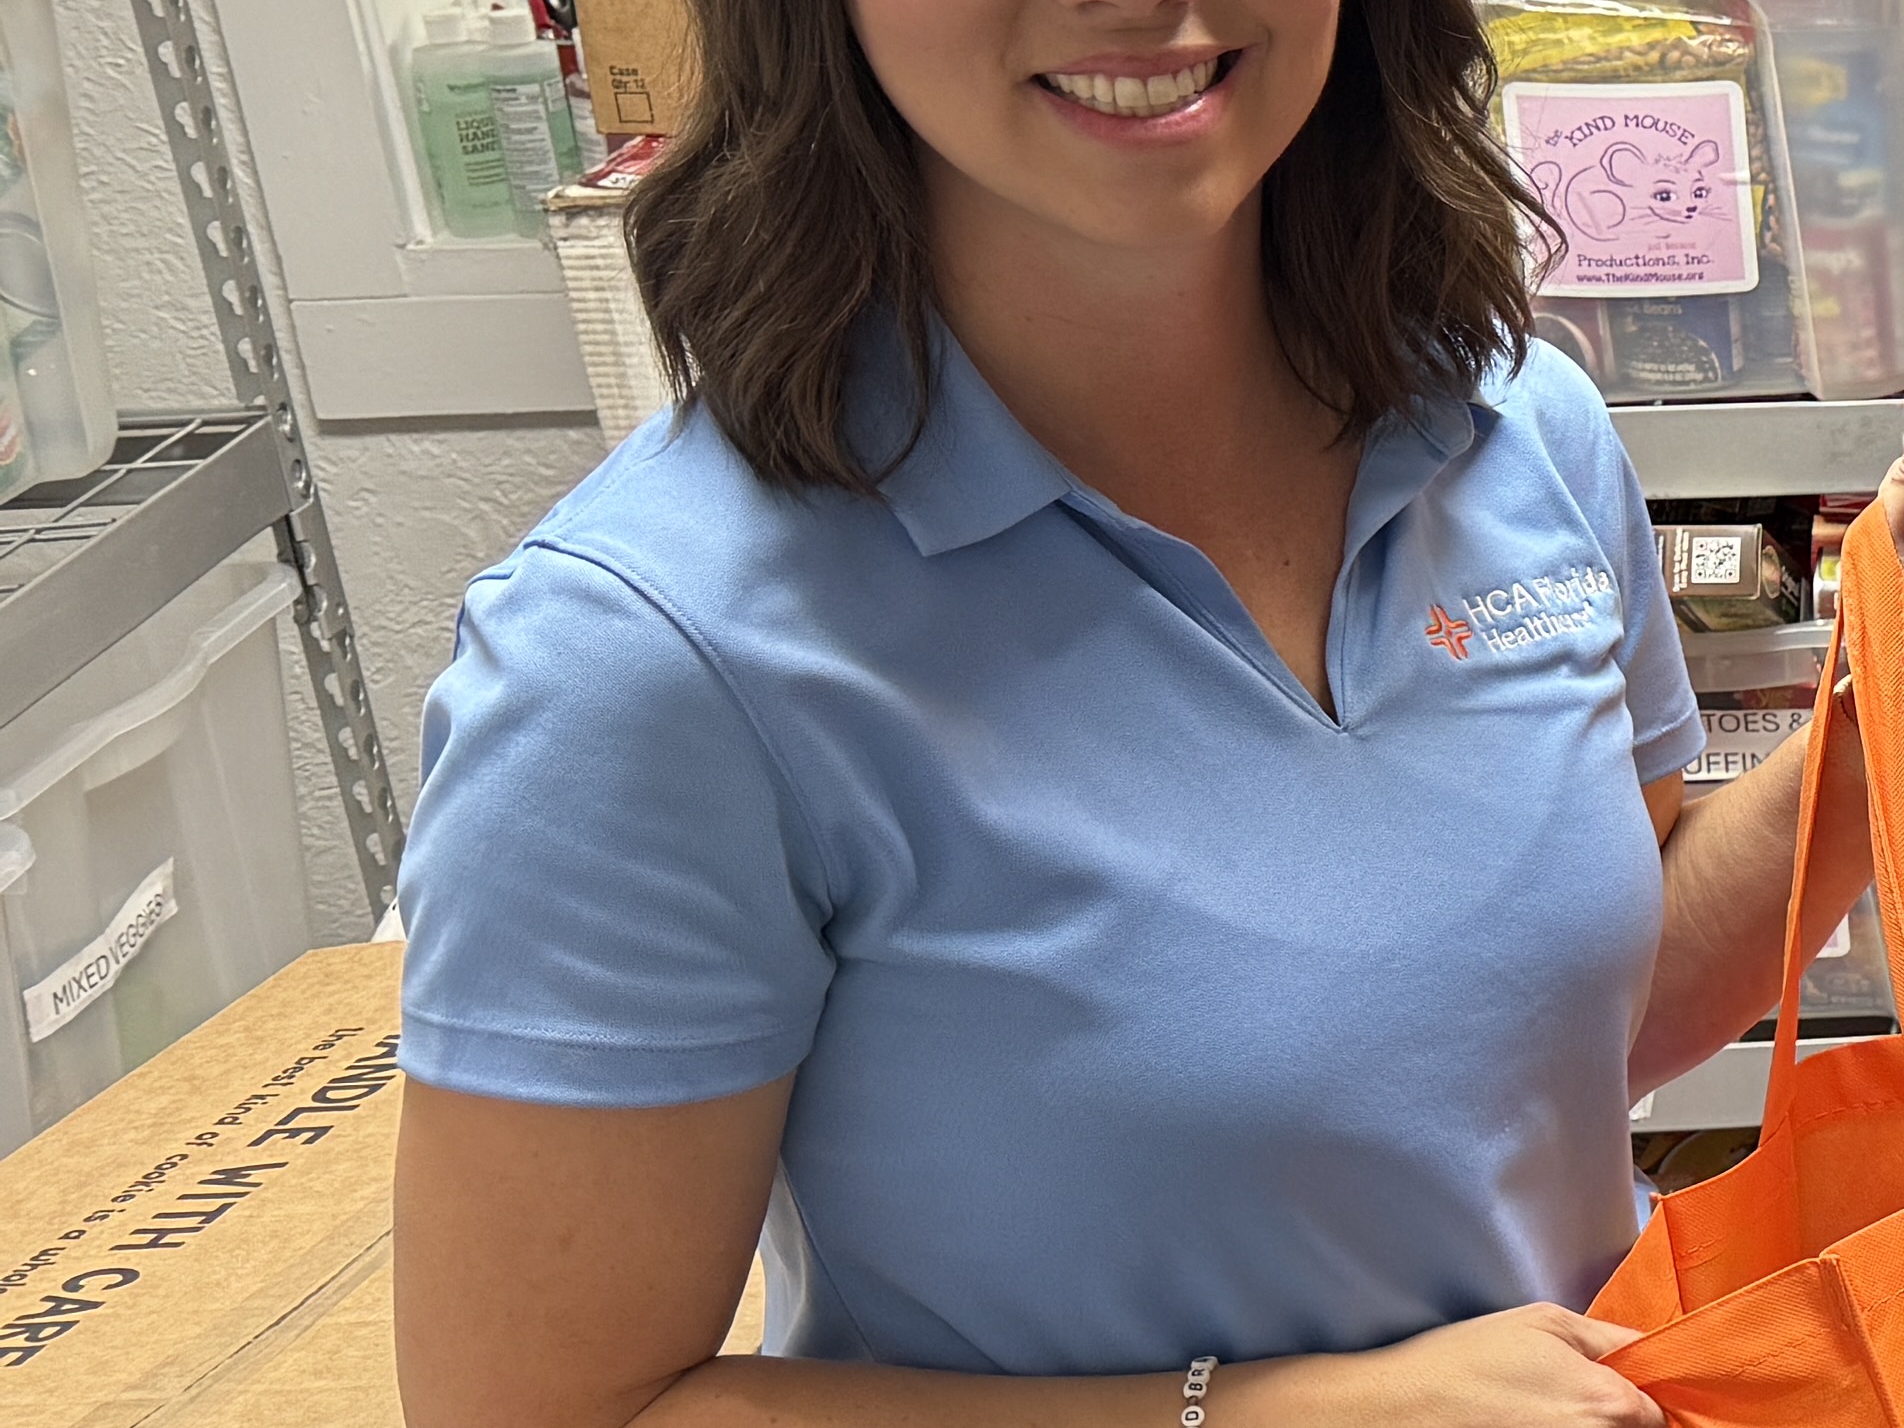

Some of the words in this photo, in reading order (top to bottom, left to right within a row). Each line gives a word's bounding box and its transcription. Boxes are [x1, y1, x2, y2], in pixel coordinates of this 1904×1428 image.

[1565, 114, 1616, 149] KIND
[1623, 113, 1696, 146] MOUSE
[1462, 581, 1540, 628] HCA
[1532, 565, 1610, 608] Florida
[50, 956, 112, 1017] MIXED
[107, 890, 167, 969] VEGGIES
[312, 1026, 365, 1052] the
[262, 1055, 329, 1089] best
[213, 1093, 281, 1127] kind
[184, 1130, 220, 1148] of
[110, 1153, 190, 1204] cookie
[83, 1208, 127, 1224] is
[108, 1161, 290, 1252] WITH
[58, 1229, 87, 1241] a
[0, 1267, 141, 1368] CARE
